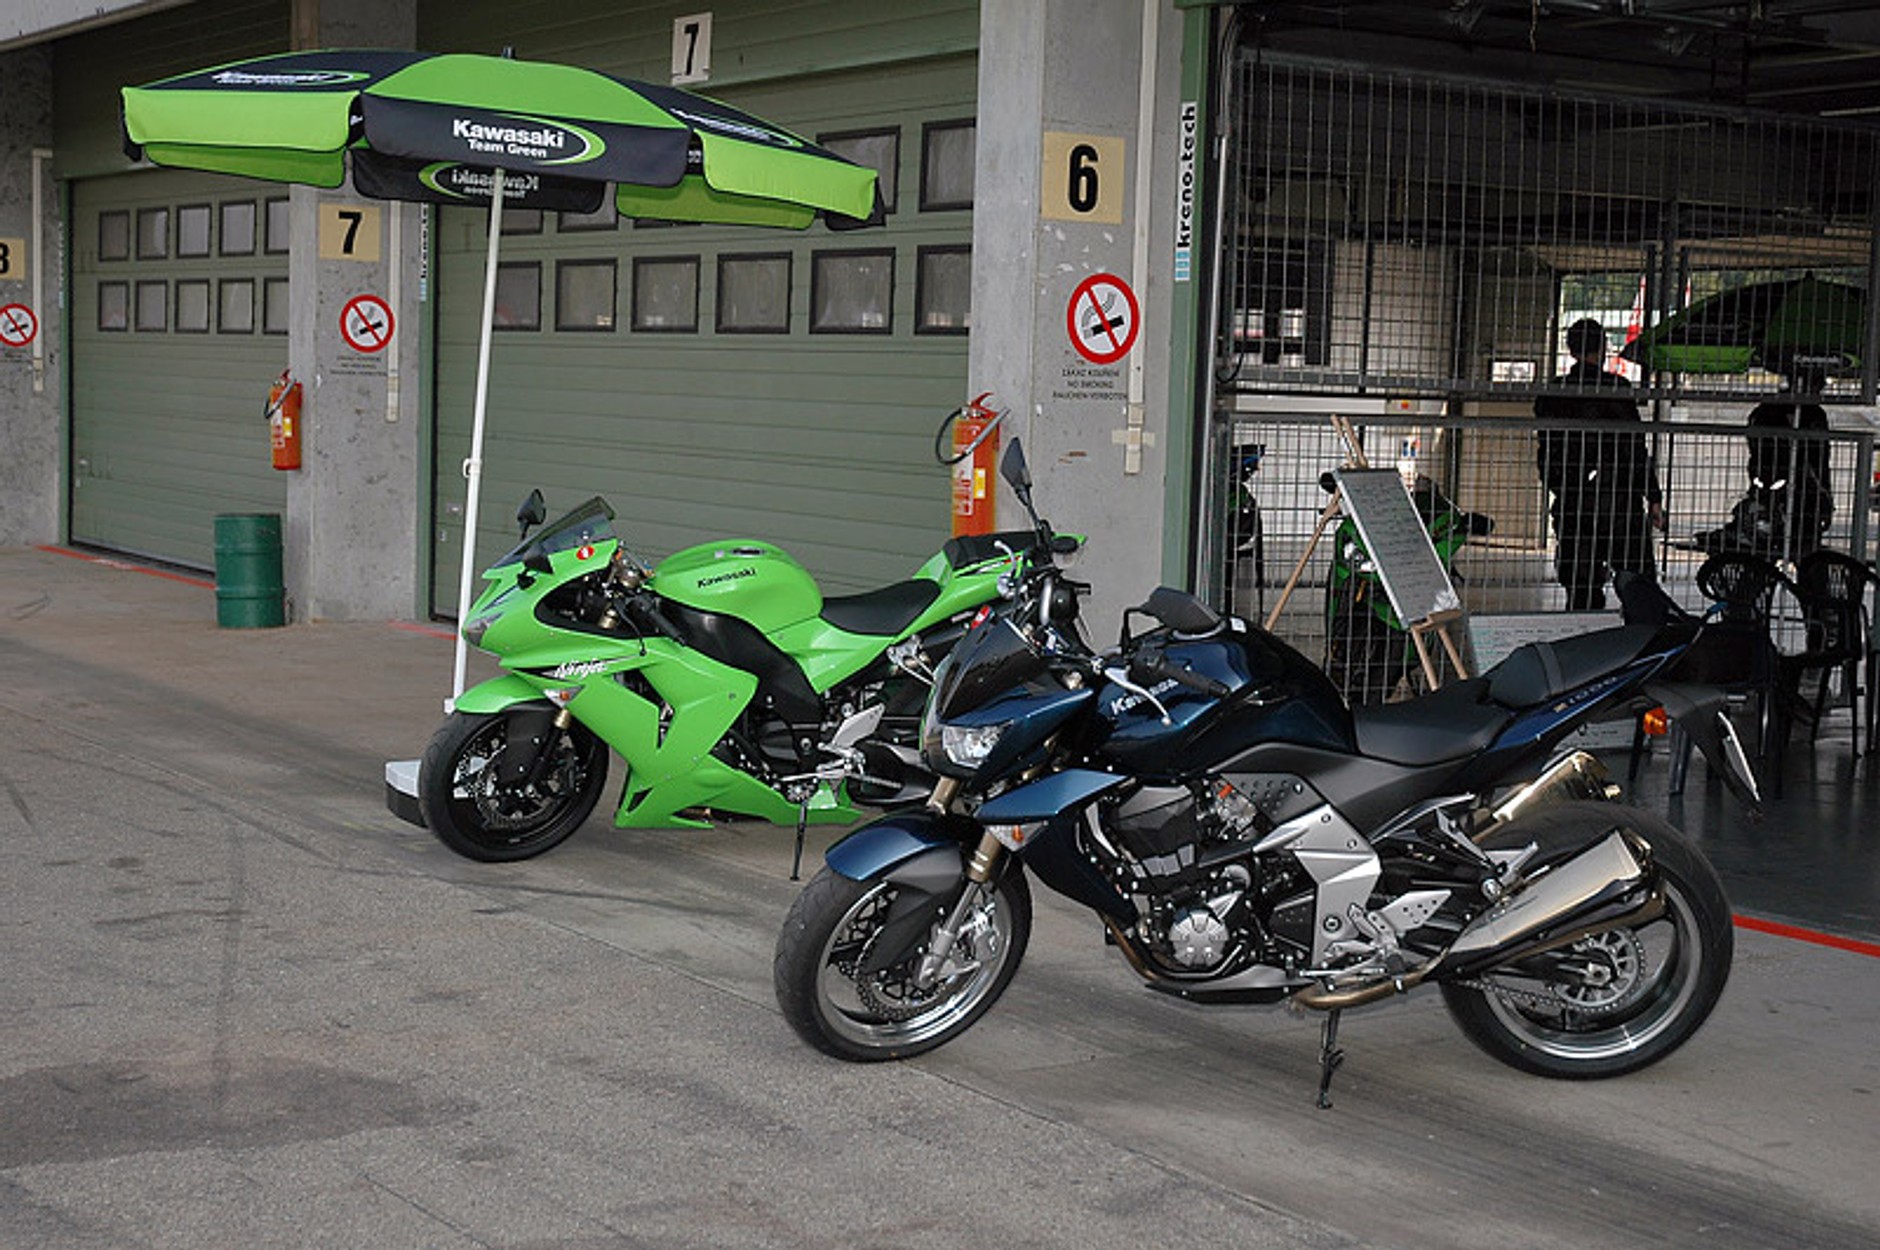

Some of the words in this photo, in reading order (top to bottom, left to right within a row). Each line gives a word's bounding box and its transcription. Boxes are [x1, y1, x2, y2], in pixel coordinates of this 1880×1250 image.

[684, 22, 699, 76] 7
[453, 119, 564, 148] Kawasaki
[467, 138, 504, 154] Team
[507, 143, 548, 158] Green
[1069, 144, 1099, 213] 6
[1177, 105, 1196, 248] kreno.tech
[338, 211, 363, 255] 7
[697, 567, 756, 588] Kawasaki
[554, 658, 606, 680] Ninja
